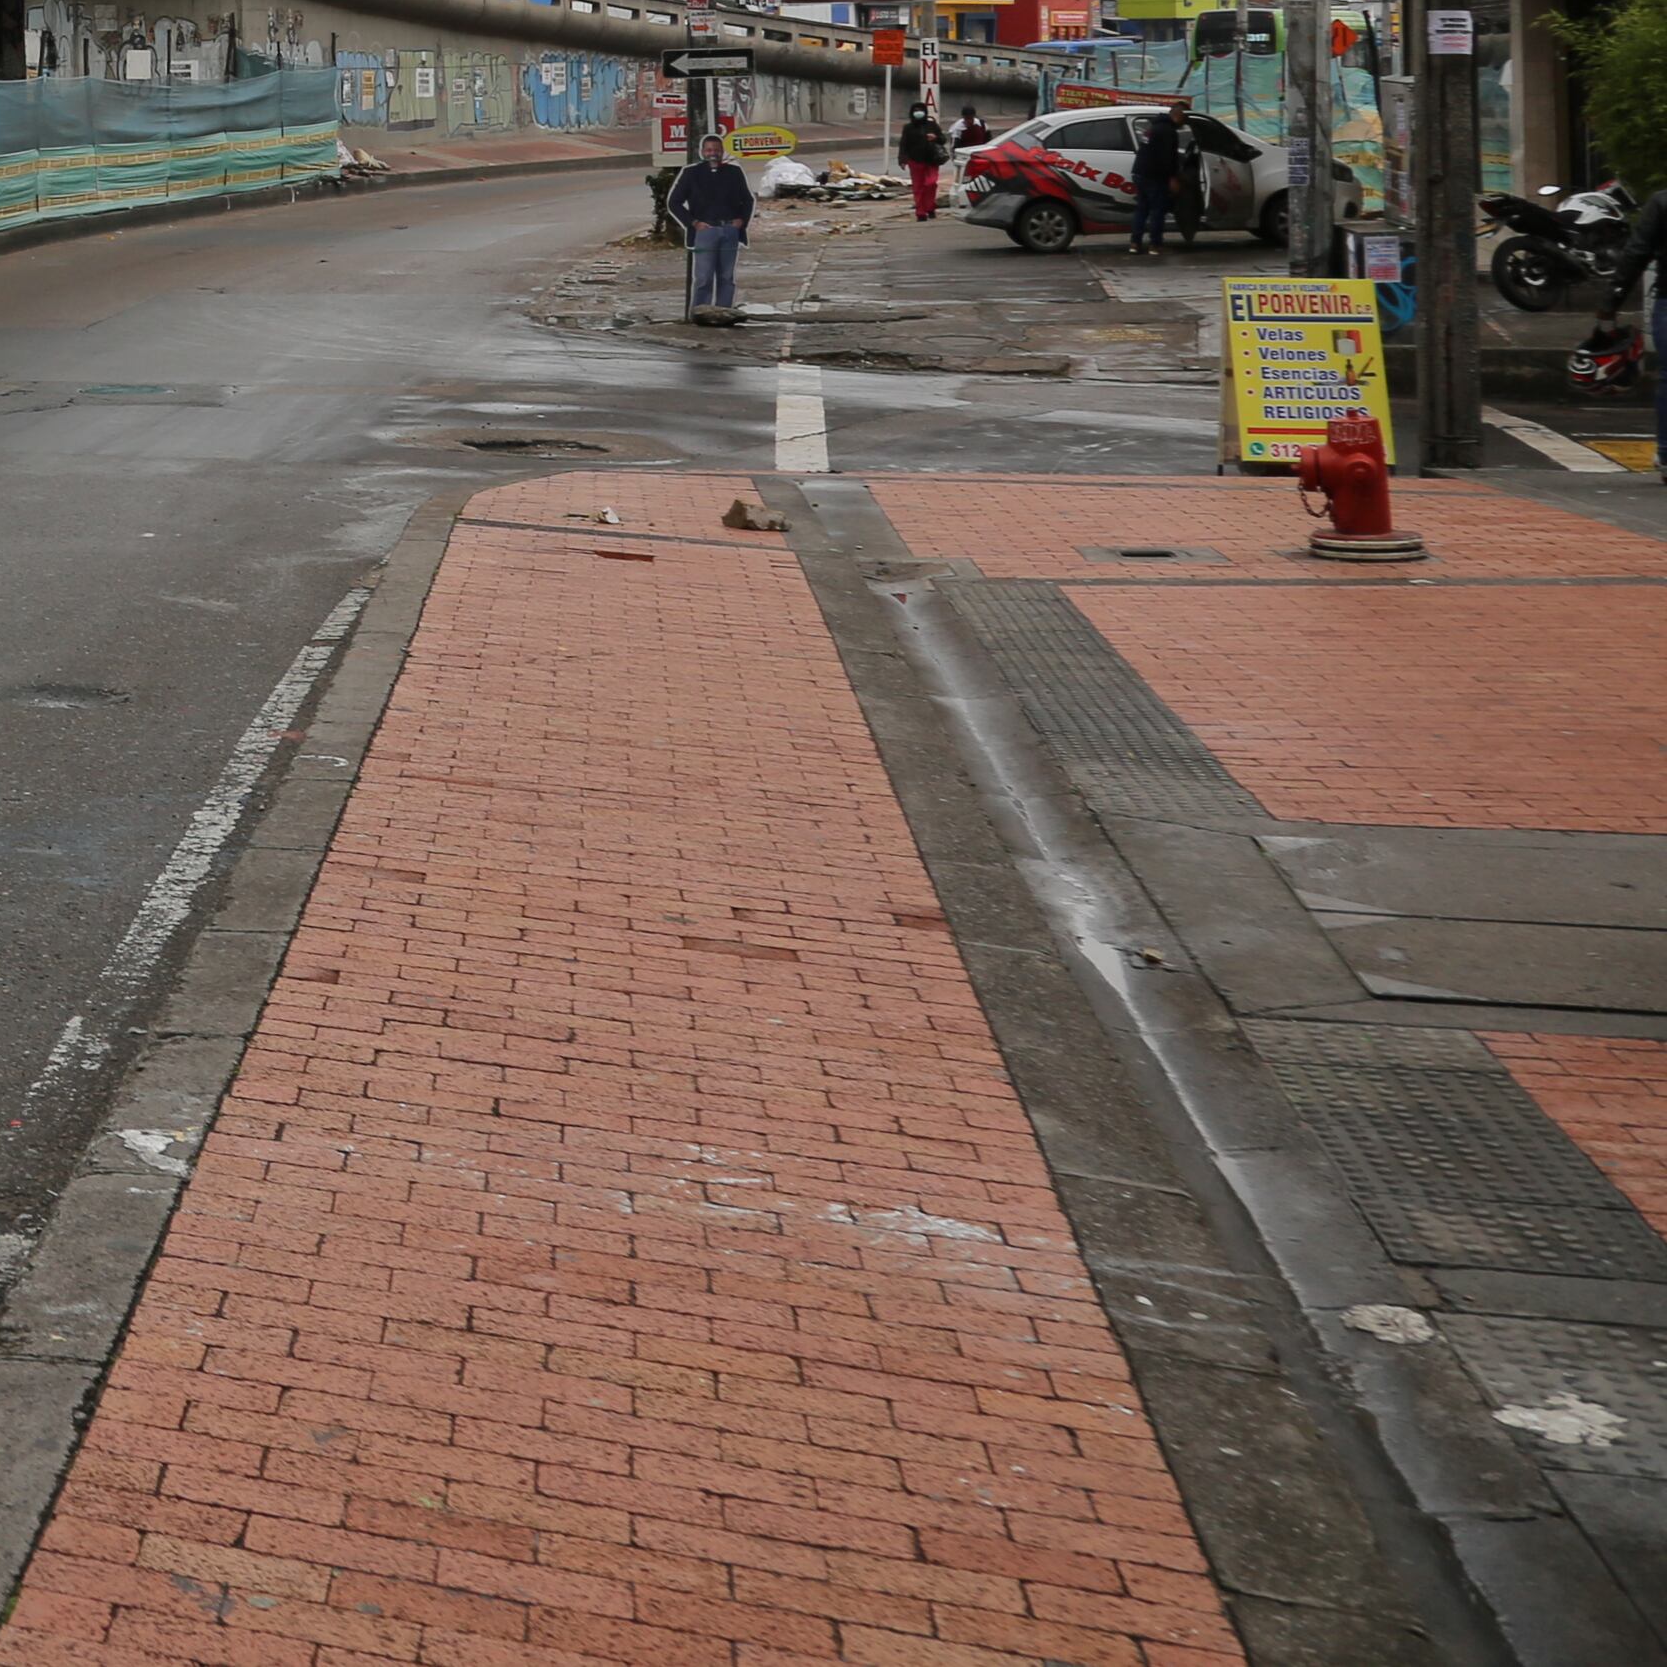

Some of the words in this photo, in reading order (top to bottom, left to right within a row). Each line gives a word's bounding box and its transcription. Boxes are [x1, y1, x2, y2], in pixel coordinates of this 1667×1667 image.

[921, 42, 938, 56] EL
[732, 138, 744, 152] EL
[1230, 293, 1255, 322] EL
[1258, 293, 1353, 315] PORVENIR
[1256, 327, 1305, 342] Velas
[1258, 347, 1327, 361] Velones
[1261, 366, 1339, 381] Esencias
[1264, 406, 1369, 420] RELIGIOSS
[1270, 444, 1302, 458] 312
